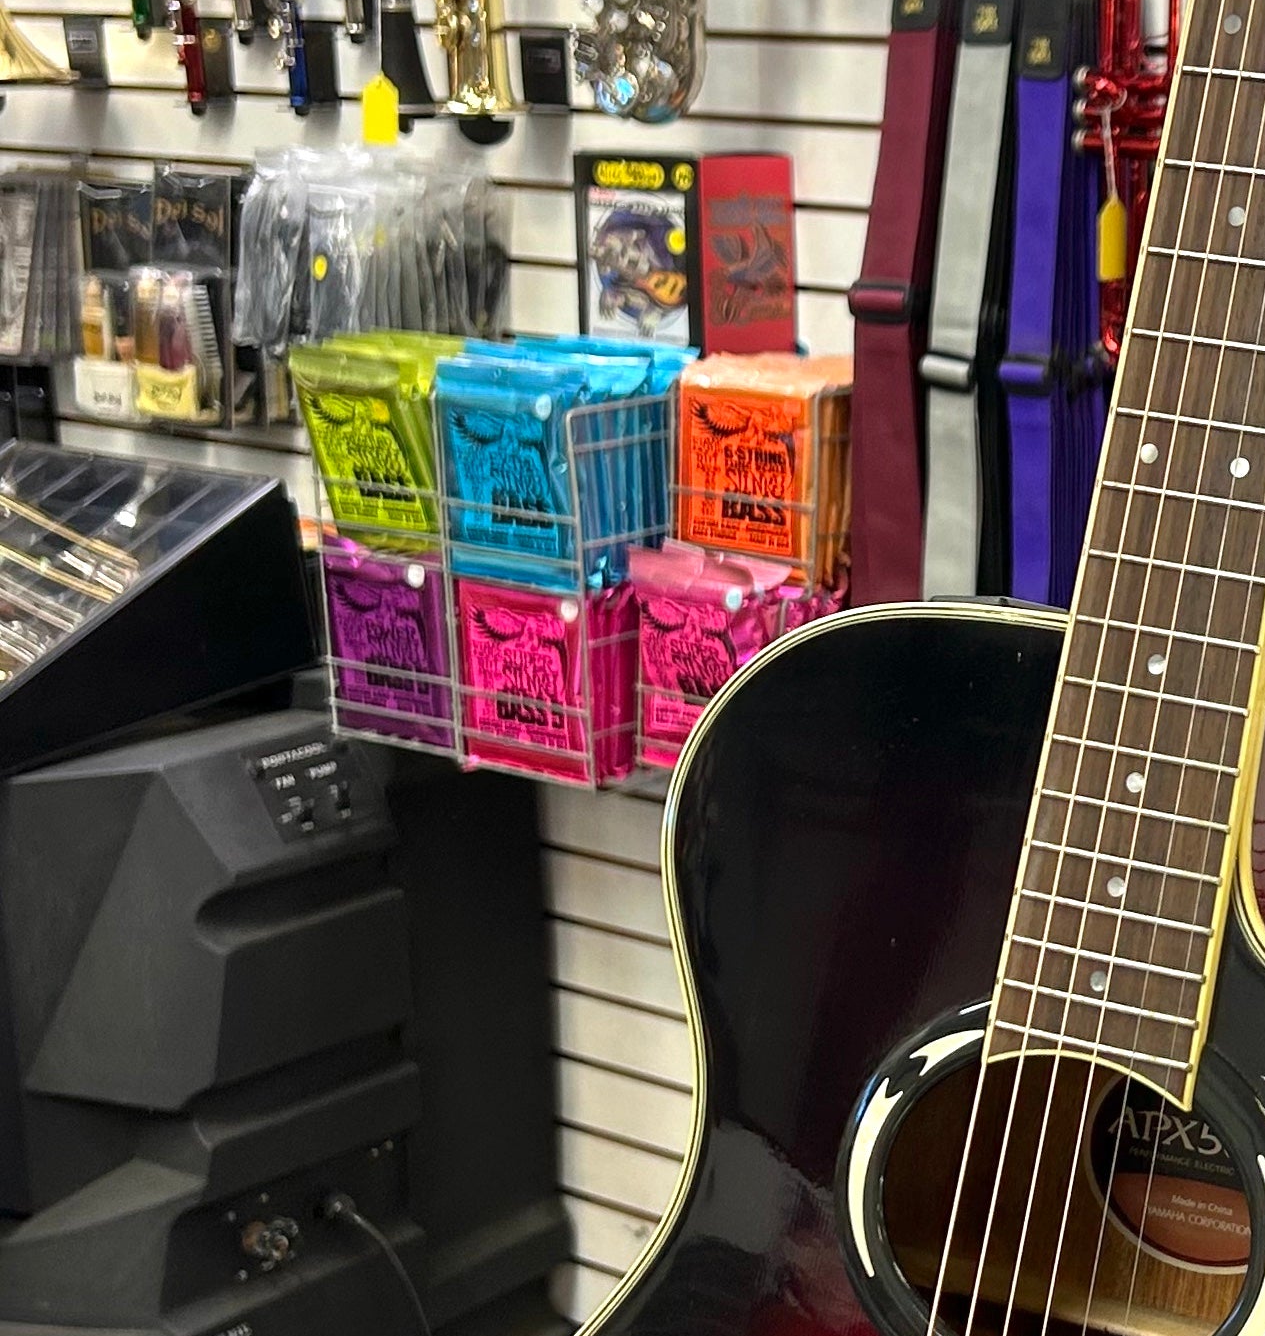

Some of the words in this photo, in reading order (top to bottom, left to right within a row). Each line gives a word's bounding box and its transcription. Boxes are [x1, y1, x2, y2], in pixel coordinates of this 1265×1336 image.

[1108, 1106, 1230, 1158] APX5
[1195, 1159, 1235, 1176] ELECTRIC
[1148, 1206, 1186, 1223] YAMAHA
[1172, 1195, 1196, 1208] Made
[1198, 1201, 1207, 1210] in
[1208, 1203, 1233, 1217] China
